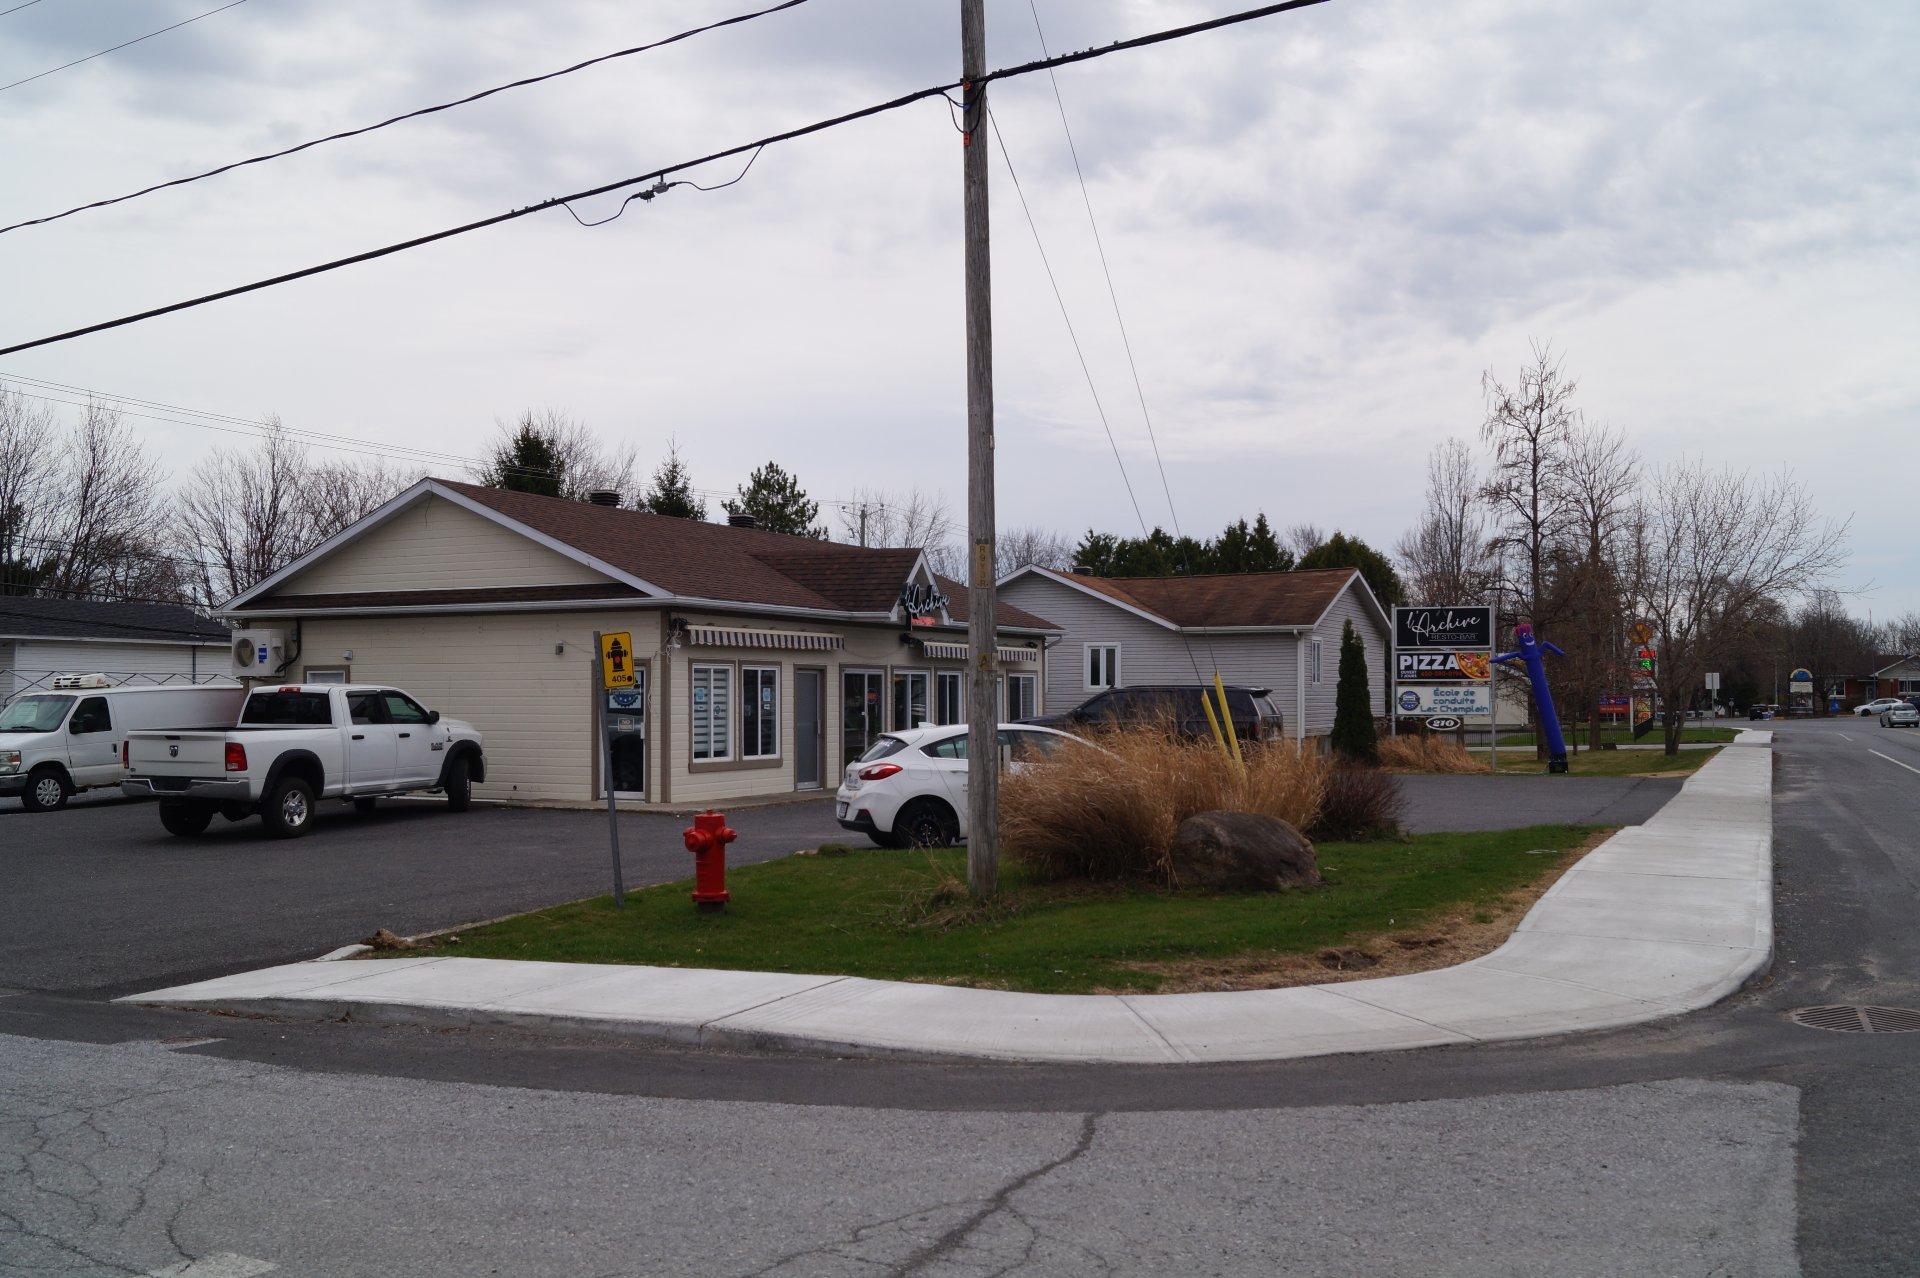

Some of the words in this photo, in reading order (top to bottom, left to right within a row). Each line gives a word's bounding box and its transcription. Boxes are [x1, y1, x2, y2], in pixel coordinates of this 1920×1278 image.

[1400, 655, 1459, 670] PIZZA
[1433, 688, 1459, 697] École
[1463, 689, 1475, 697] de
[1440, 705, 1489, 714] Champlain
